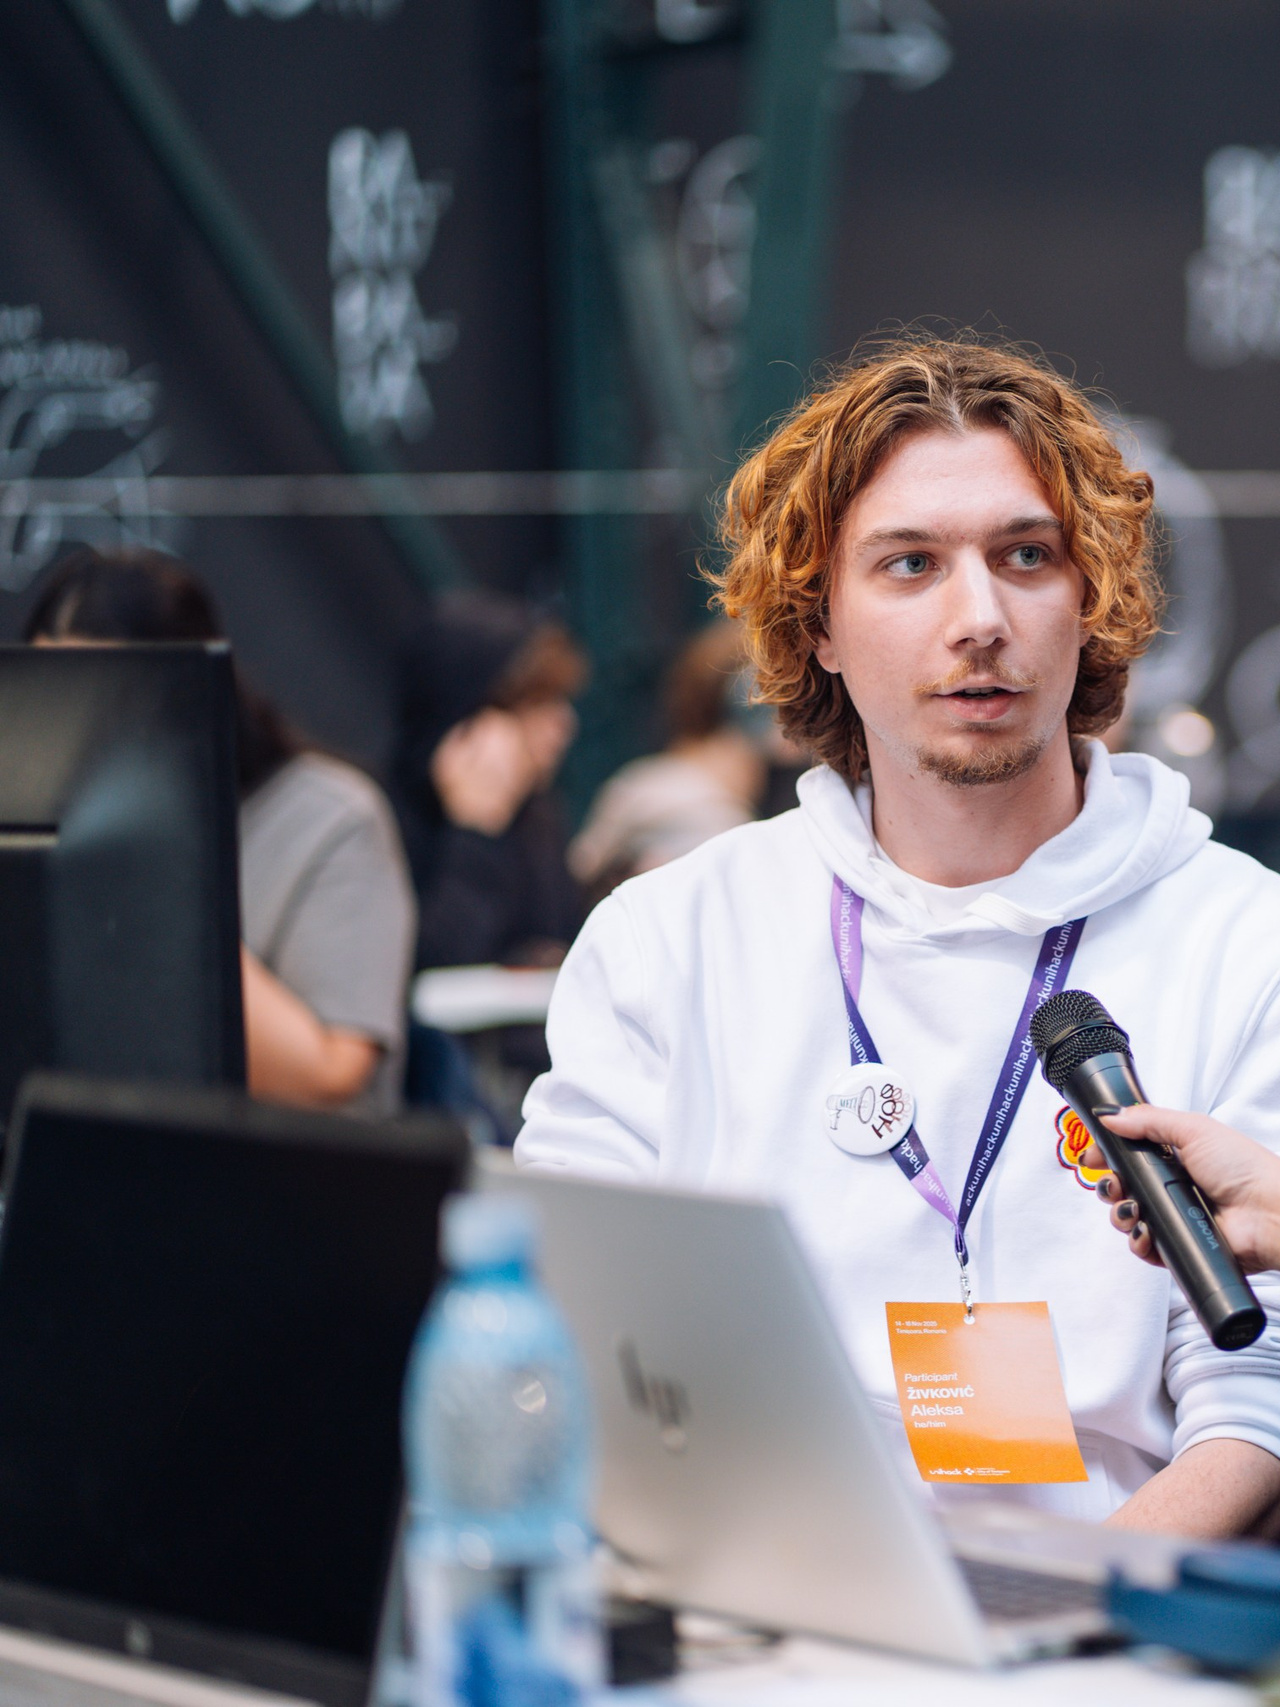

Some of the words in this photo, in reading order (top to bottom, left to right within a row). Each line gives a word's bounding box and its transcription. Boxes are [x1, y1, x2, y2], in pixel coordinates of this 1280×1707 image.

[1197, 1220, 1219, 1250] BOYA
[904, 1372, 958, 1382] Participant
[911, 1404, 964, 1416] Aleksa
[914, 1420, 946, 1428] he/him
